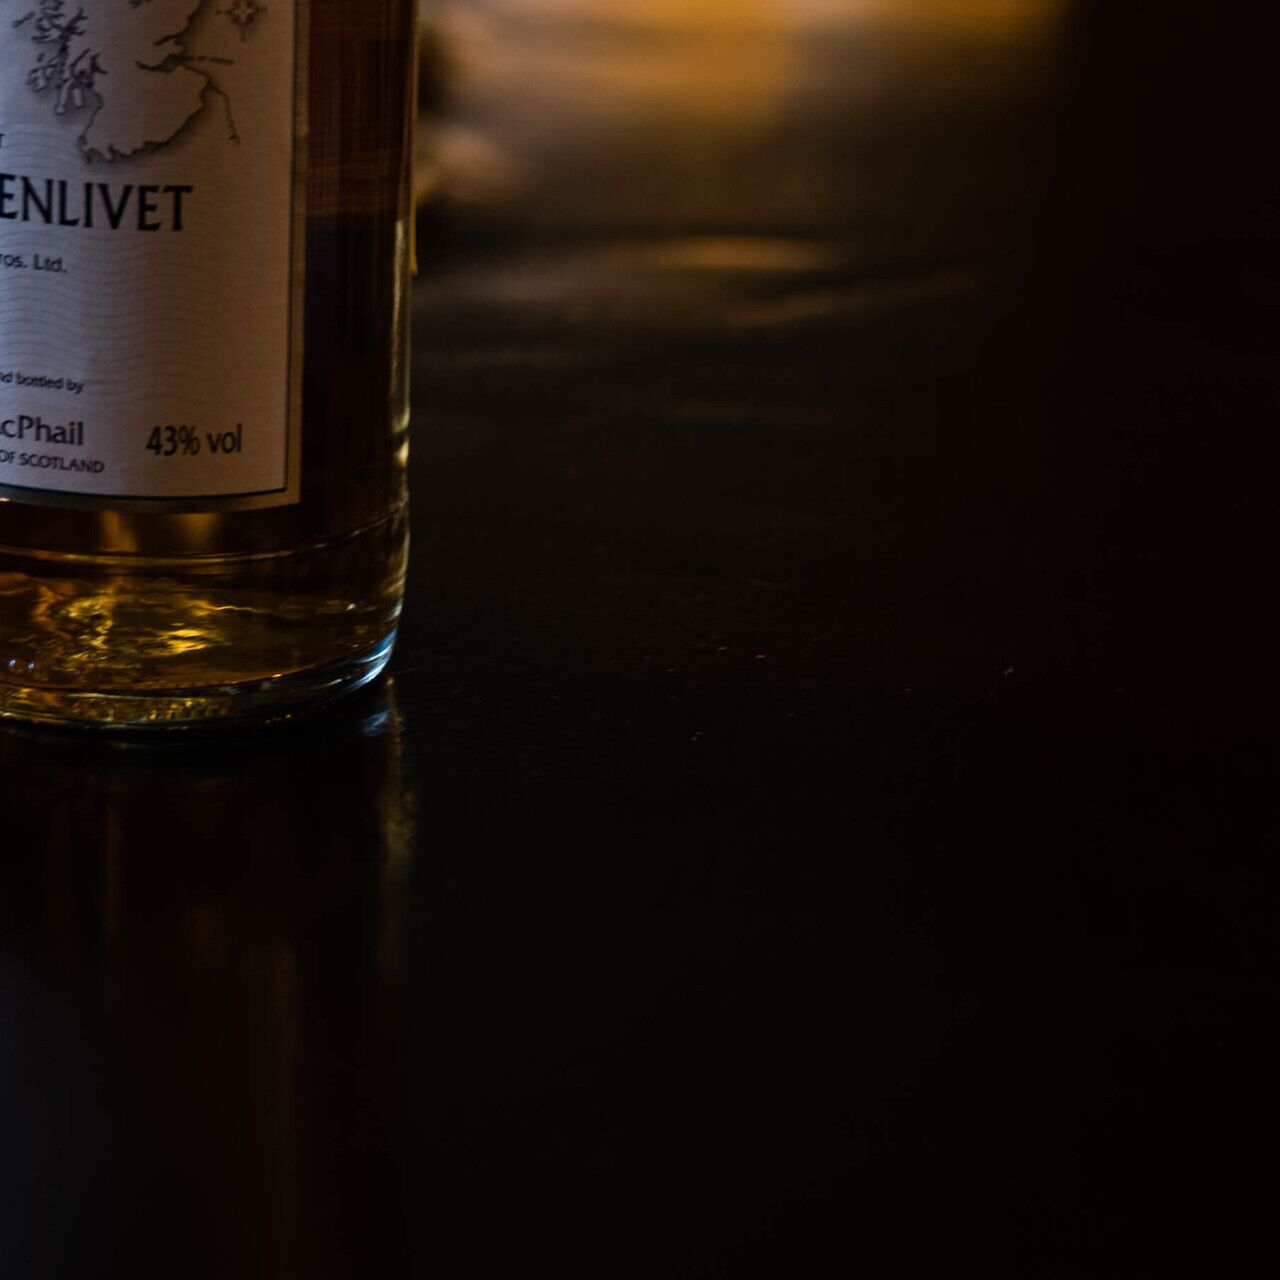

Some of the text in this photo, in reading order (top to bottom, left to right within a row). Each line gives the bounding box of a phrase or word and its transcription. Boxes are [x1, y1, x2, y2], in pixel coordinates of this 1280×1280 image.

[33, 253, 68, 274] Ltd.
[15, 372, 64, 391] bottled
[65, 378, 85, 395] by
[145, 423, 243, 456] 43% vol
[18, 452, 106, 474] SCOTLAND
